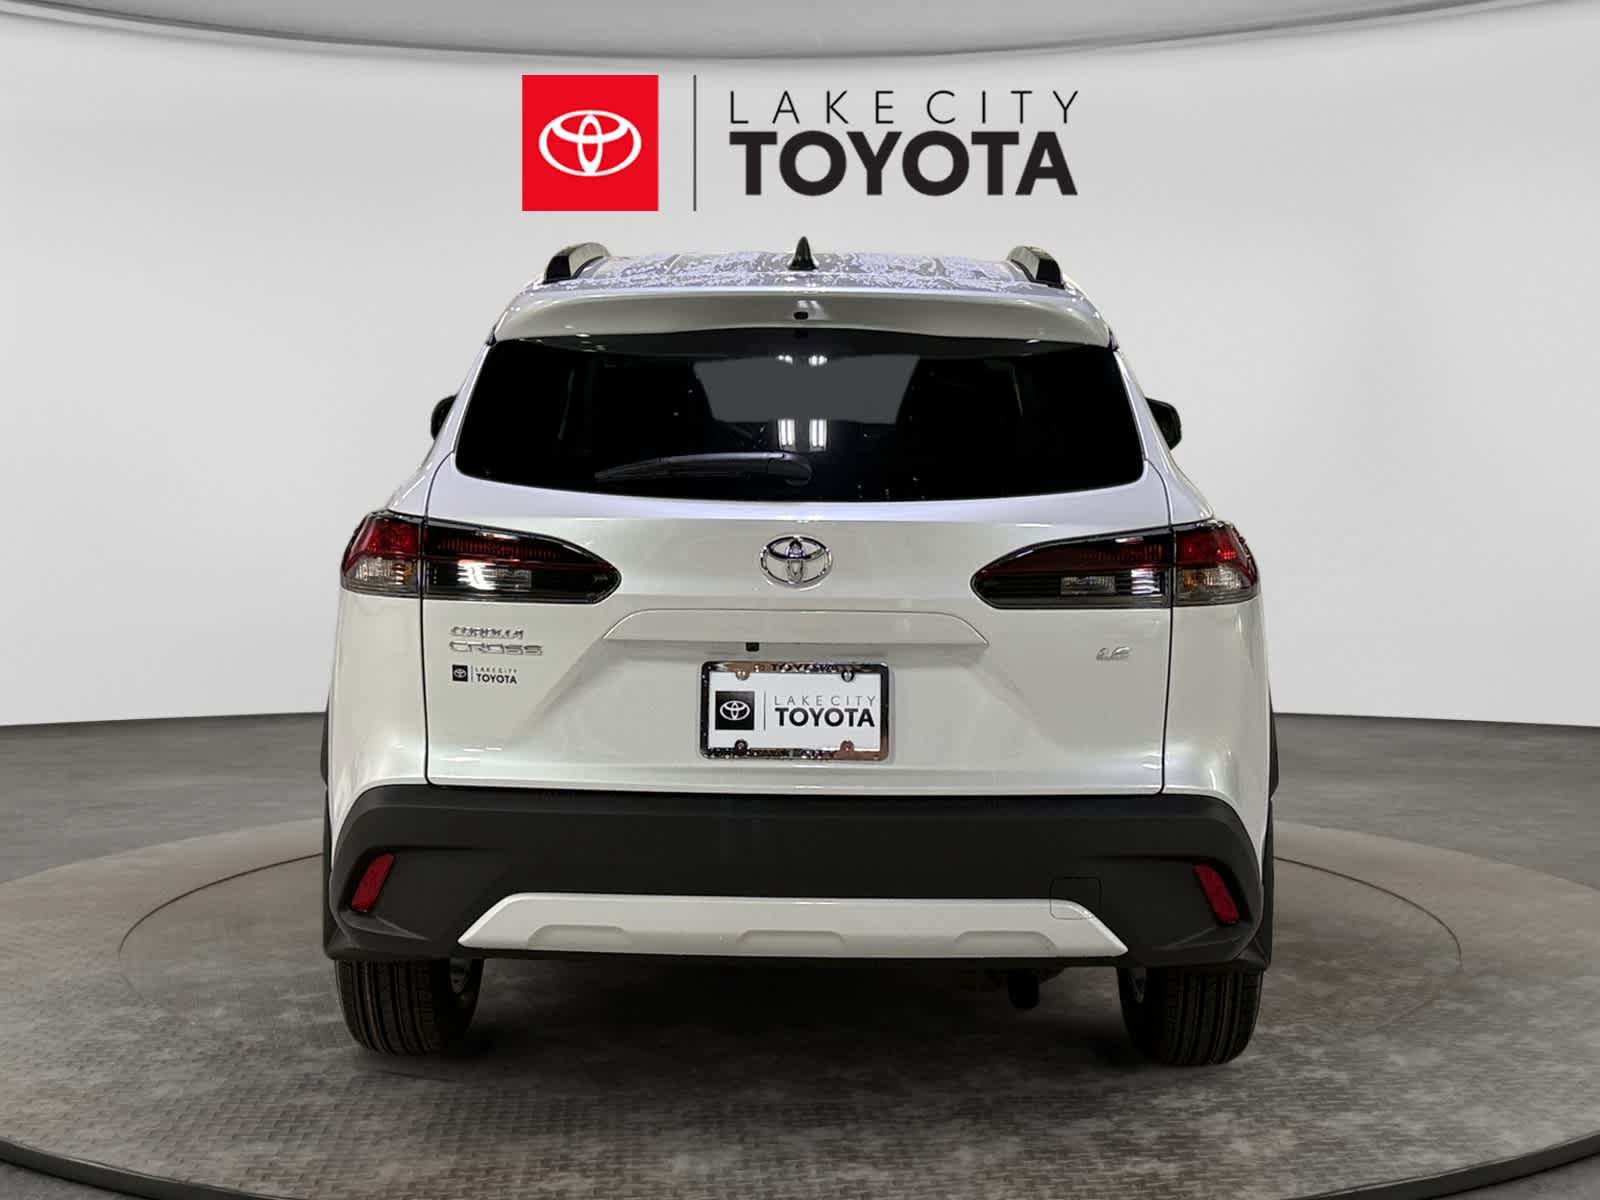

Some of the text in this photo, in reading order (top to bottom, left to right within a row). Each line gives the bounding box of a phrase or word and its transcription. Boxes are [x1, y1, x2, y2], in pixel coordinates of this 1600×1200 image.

[449, 640, 543, 655] CROSS
[476, 673, 518, 684] TOYOTA
[773, 695, 877, 706] LAKE CITY
[774, 707, 876, 727] TOYOTA
